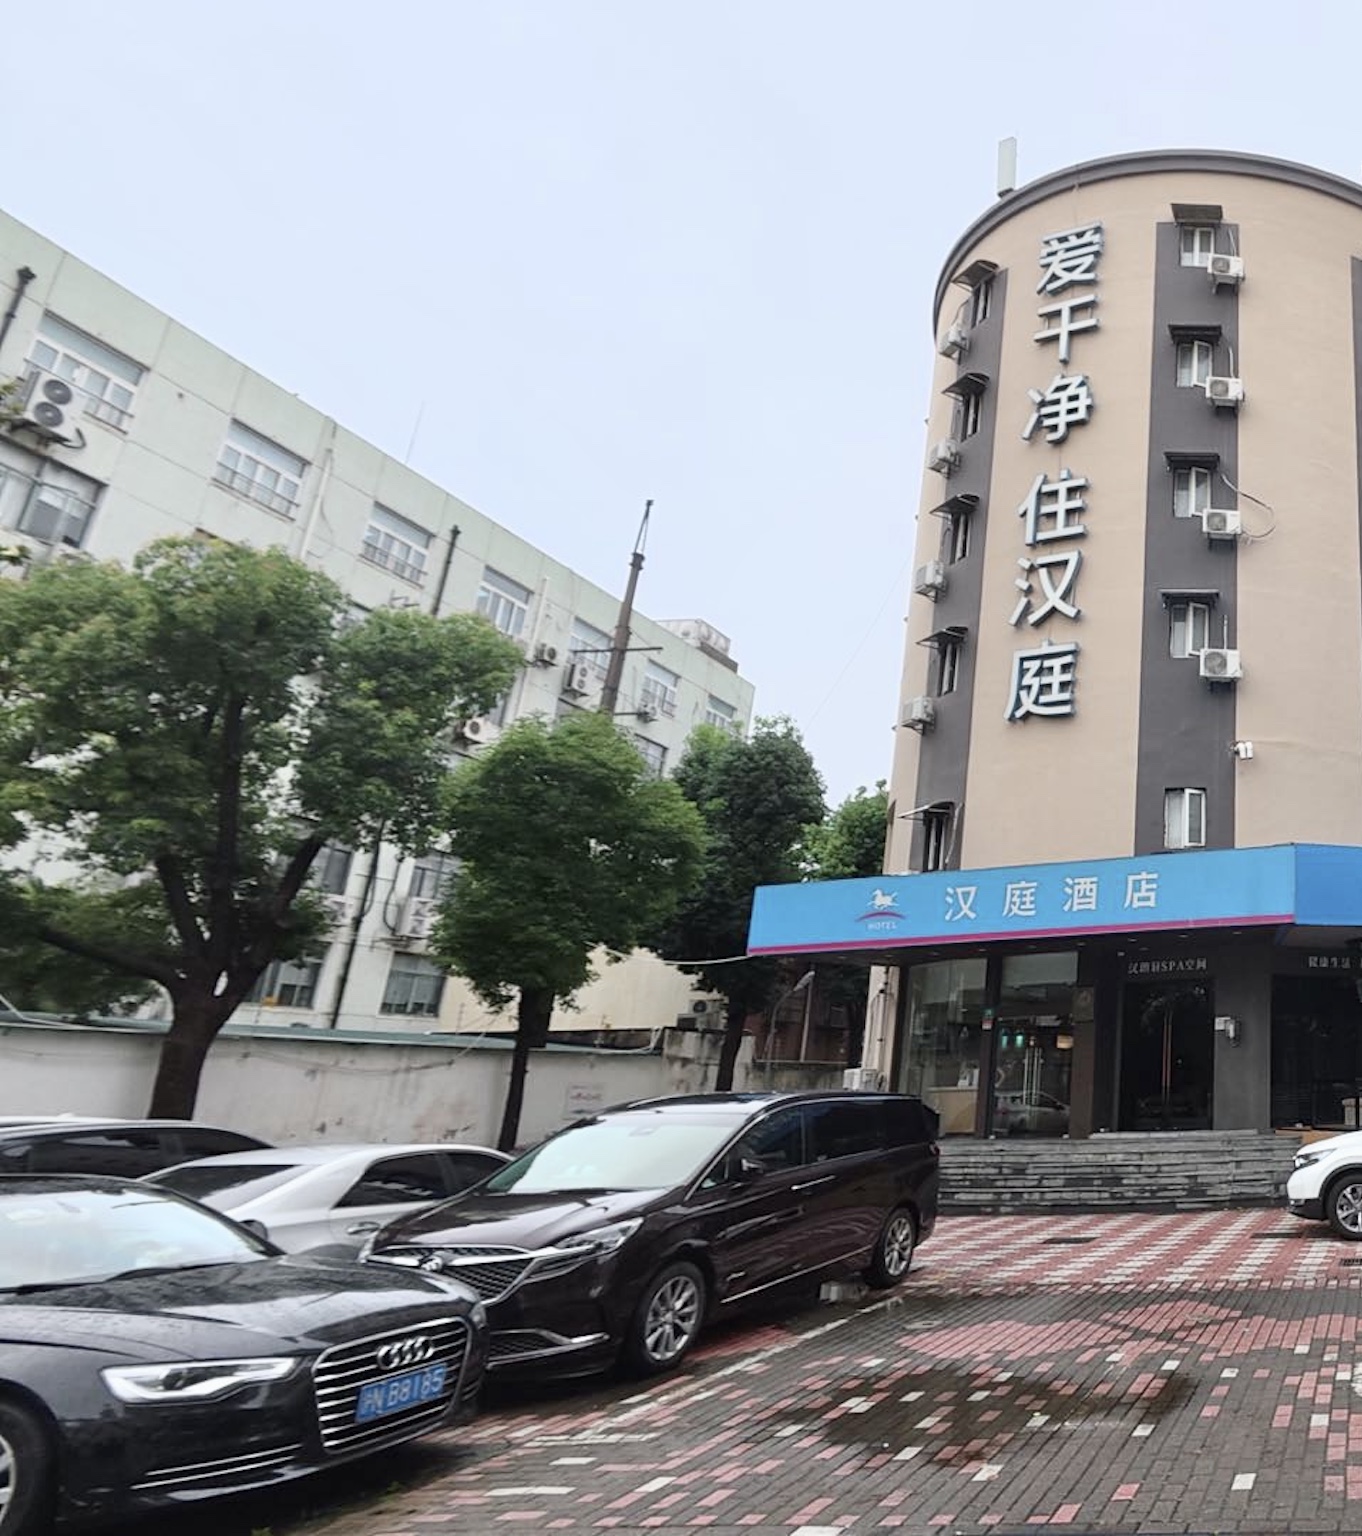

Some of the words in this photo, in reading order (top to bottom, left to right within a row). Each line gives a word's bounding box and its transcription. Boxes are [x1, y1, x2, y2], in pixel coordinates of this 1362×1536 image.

[944, 871, 1159, 922] 汉庭酒店
[866, 921, 898, 931] HOTEL
